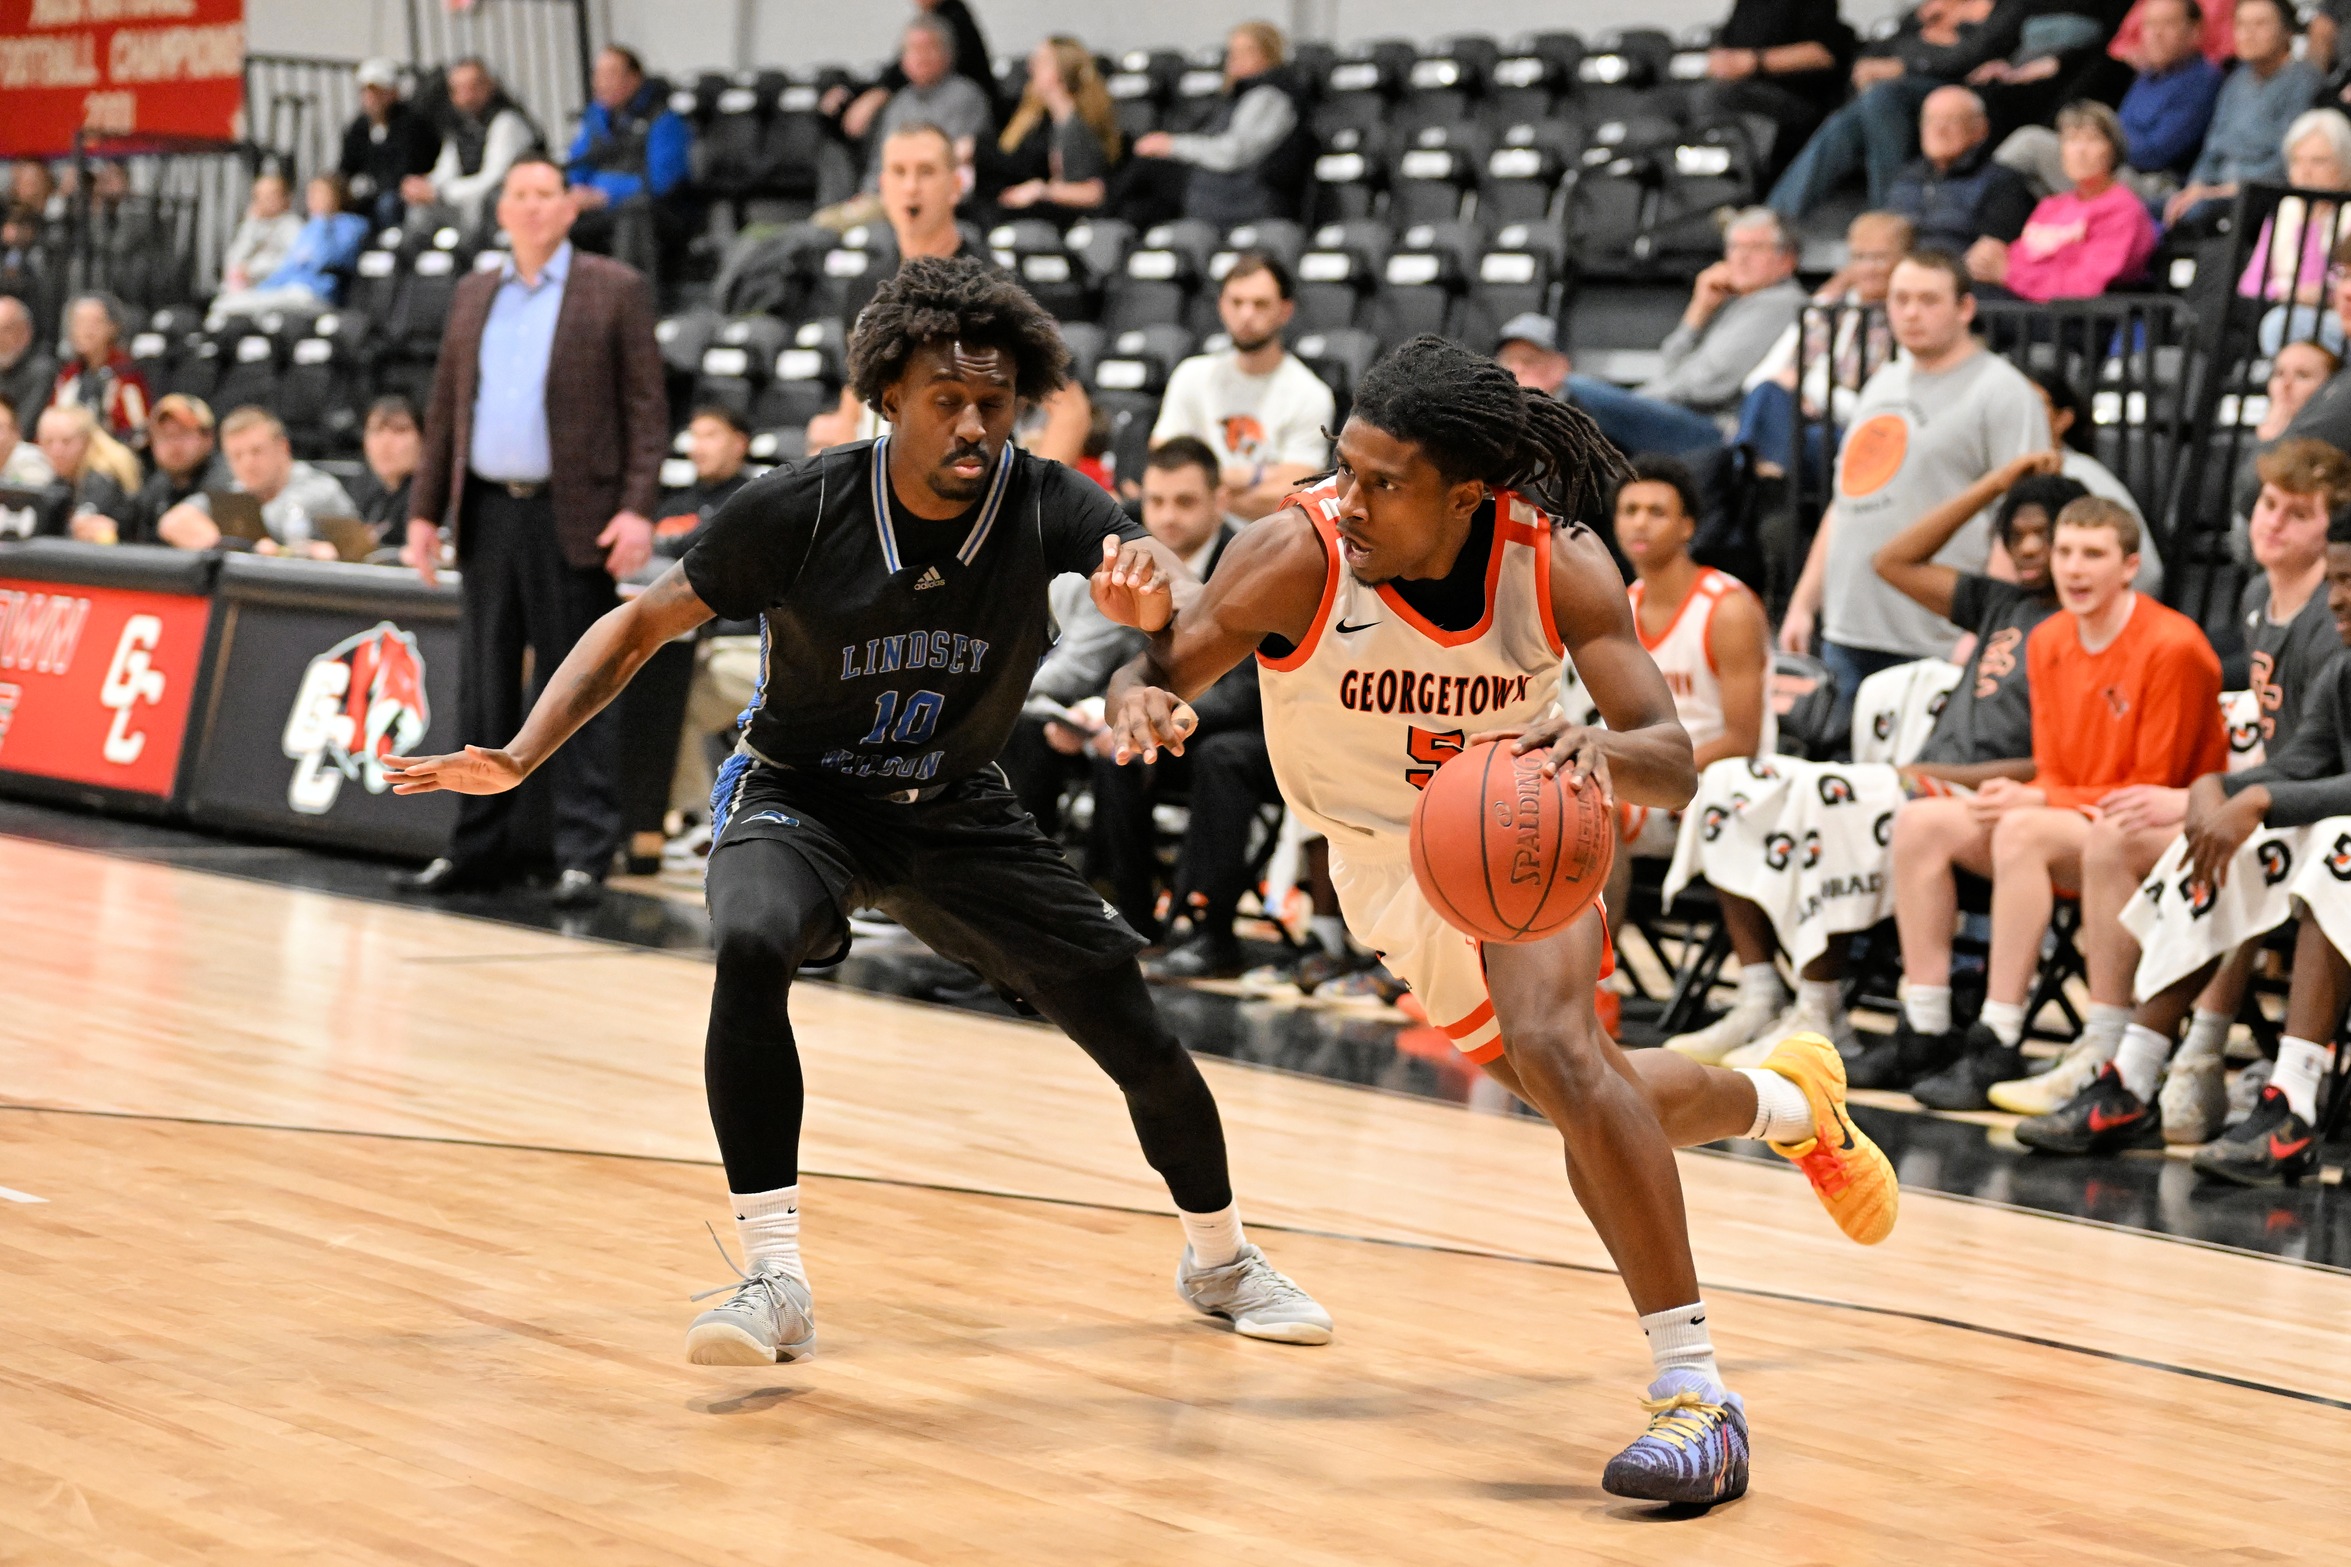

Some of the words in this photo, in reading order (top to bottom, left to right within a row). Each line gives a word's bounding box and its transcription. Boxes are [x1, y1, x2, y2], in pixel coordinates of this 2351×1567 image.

[913, 578, 946, 590] adidas
[840, 630, 990, 681] LINDSEY
[859, 689, 946, 745] 10
[1339, 669, 1533, 717] GEORGETOWN
[1405, 725, 1466, 792] 5
[1509, 756, 1544, 886] SPALDING
